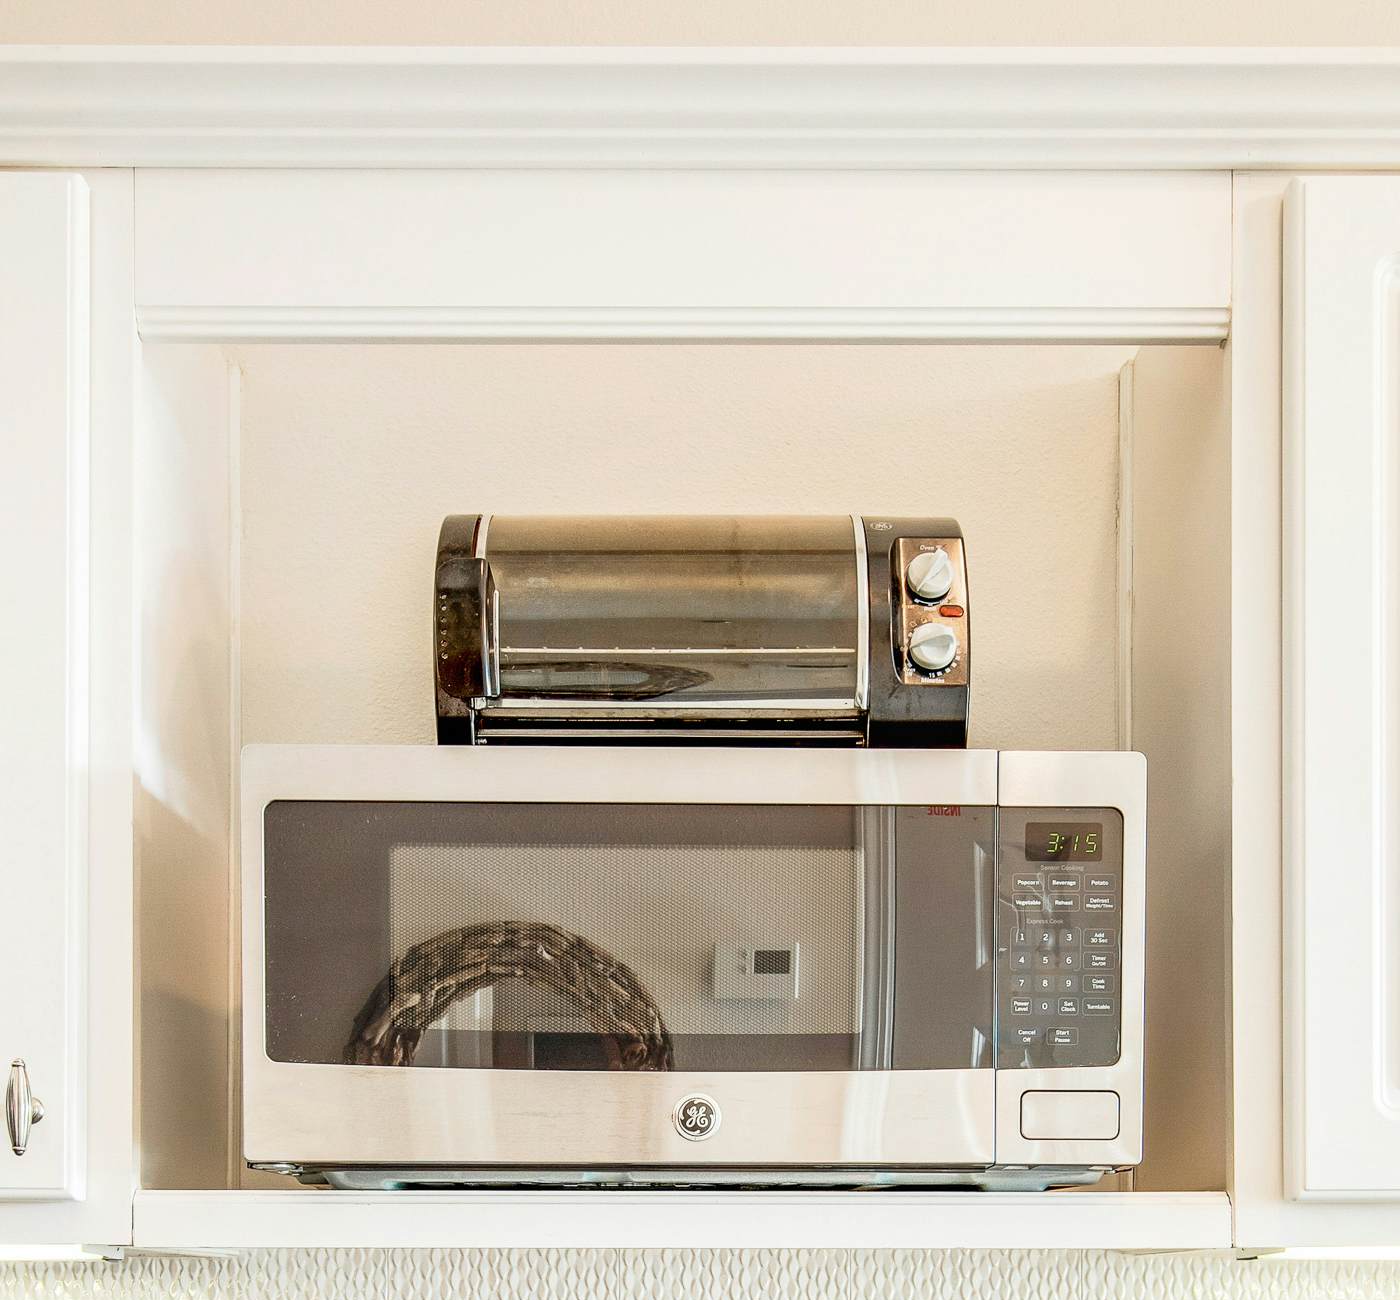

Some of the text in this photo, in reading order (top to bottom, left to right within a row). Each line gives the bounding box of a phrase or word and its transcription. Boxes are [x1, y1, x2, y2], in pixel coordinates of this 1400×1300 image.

[1047, 833, 1097, 853] 3:15
[1020, 933, 1025, 941] 1
[1042, 933, 1049, 941] 2
[1066, 933, 1073, 941] 3
[1018, 956, 1025, 964] 4
[1042, 956, 1049, 964] 5
[1066, 956, 1073, 965] 6
[1019, 979, 1025, 987] 7
[1042, 979, 1049, 987] 8
[1065, 979, 1072, 988] 9
[1041, 1002, 1048, 1010] 0
